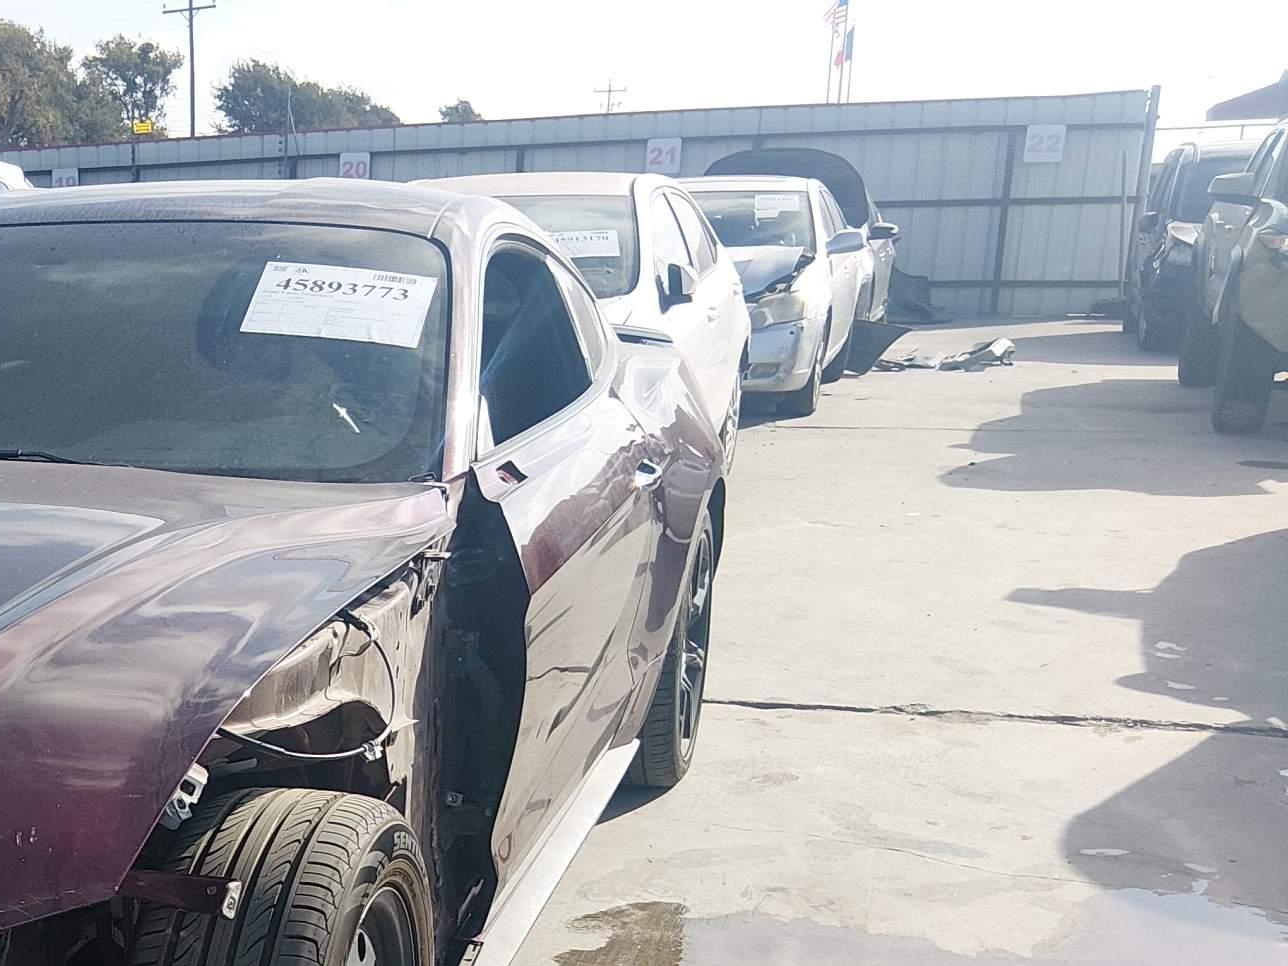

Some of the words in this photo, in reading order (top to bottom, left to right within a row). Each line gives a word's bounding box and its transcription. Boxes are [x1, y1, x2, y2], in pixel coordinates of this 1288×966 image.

[1027, 133, 1063, 153] 22
[648, 146, 677, 166] 21
[343, 160, 368, 177] 20
[276, 277, 409, 301] 45893773
